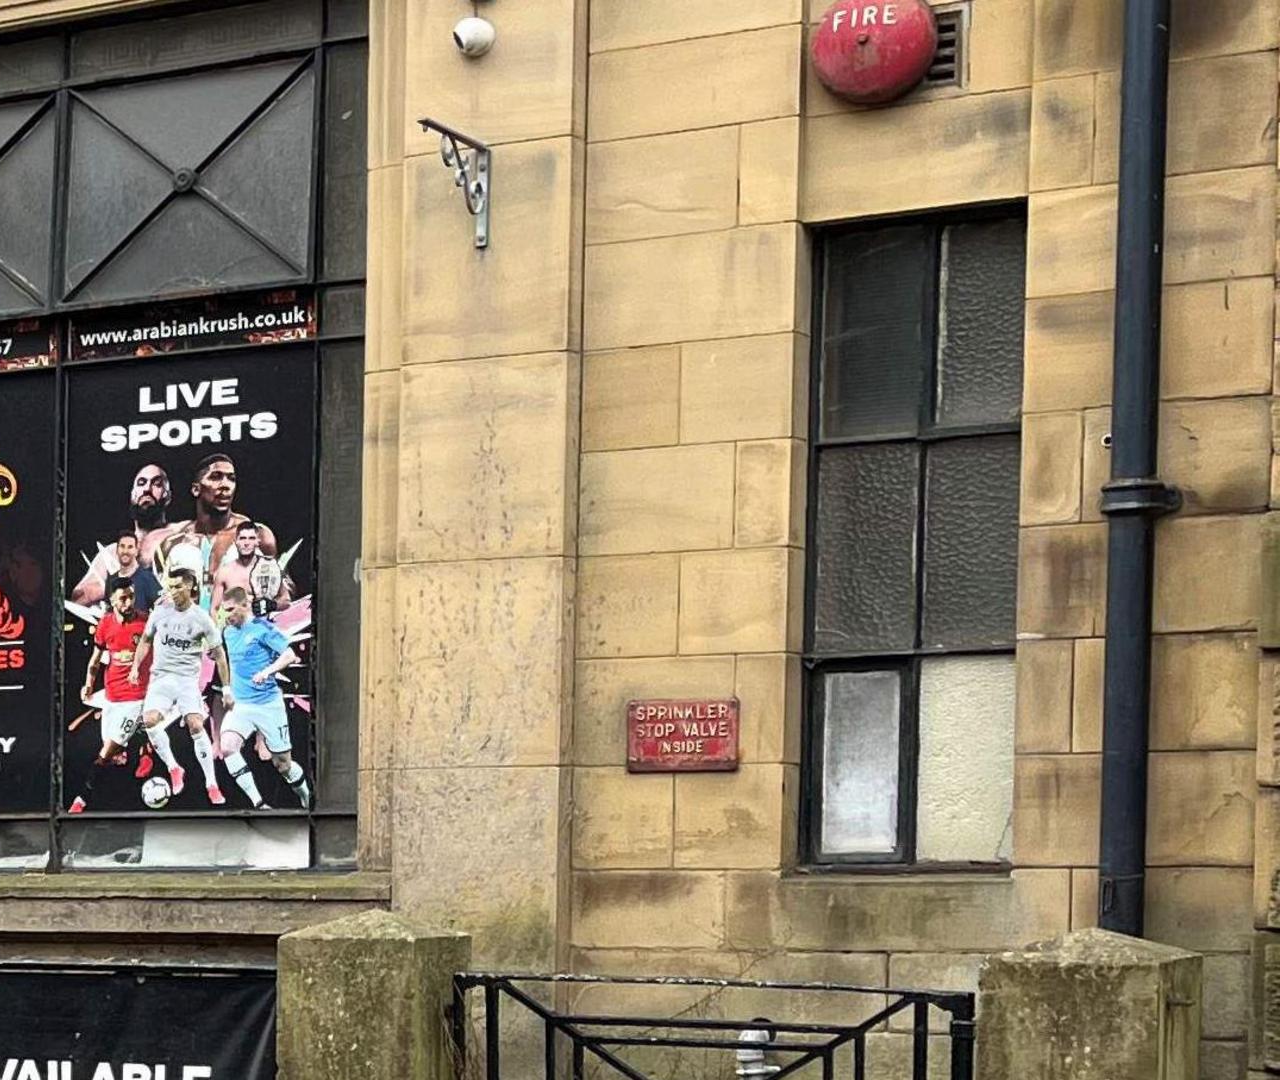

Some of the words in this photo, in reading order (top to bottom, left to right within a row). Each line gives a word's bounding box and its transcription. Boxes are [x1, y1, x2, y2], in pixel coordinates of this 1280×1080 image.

[832, 4, 898, 33] FIRE
[80, 306, 305, 346] www.arabiankrush.co.uk
[139, 378, 240, 413] LIVE
[100, 411, 278, 452] SPORTS
[161, 634, 192, 650] Jeep
[635, 703, 729, 721] SPRINKLER
[121, 716, 134, 734] 18
[278, 724, 289, 740] 17
[636, 722, 675, 738] STOP
[682, 721, 729, 737] VALVE
